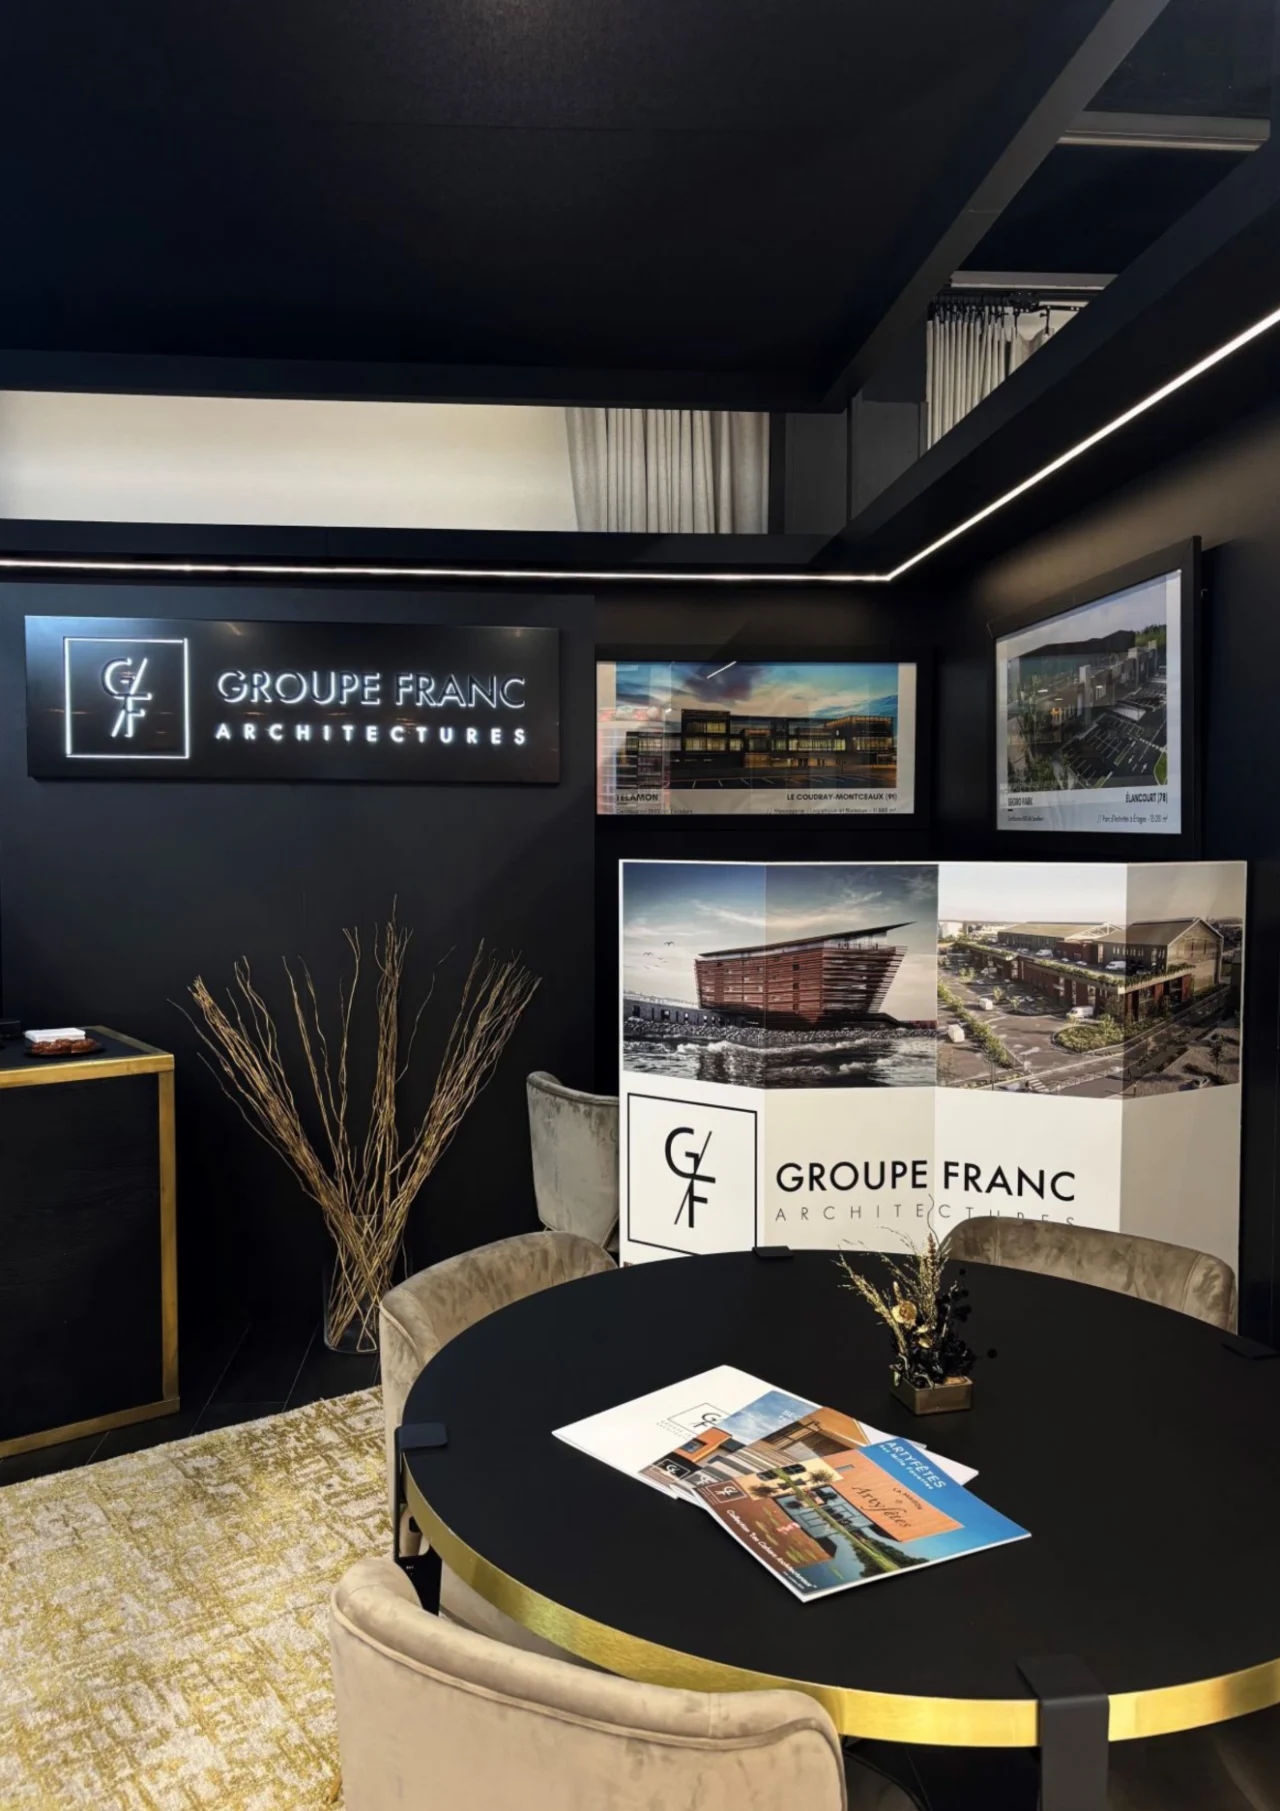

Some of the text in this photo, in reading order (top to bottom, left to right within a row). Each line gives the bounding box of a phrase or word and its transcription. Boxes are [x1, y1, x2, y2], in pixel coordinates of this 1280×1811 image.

[216, 669, 526, 709] GROUPE FRANC
[214, 722, 527, 746] ARCHITECTURES
[786, 793, 795, 801] LE
[796, 792, 883, 801] COUDRAY-MONTCEAUX
[776, 1160, 1076, 1201] GROUPE FRANC
[886, 1442, 947, 1489] ARTYFÊTES
